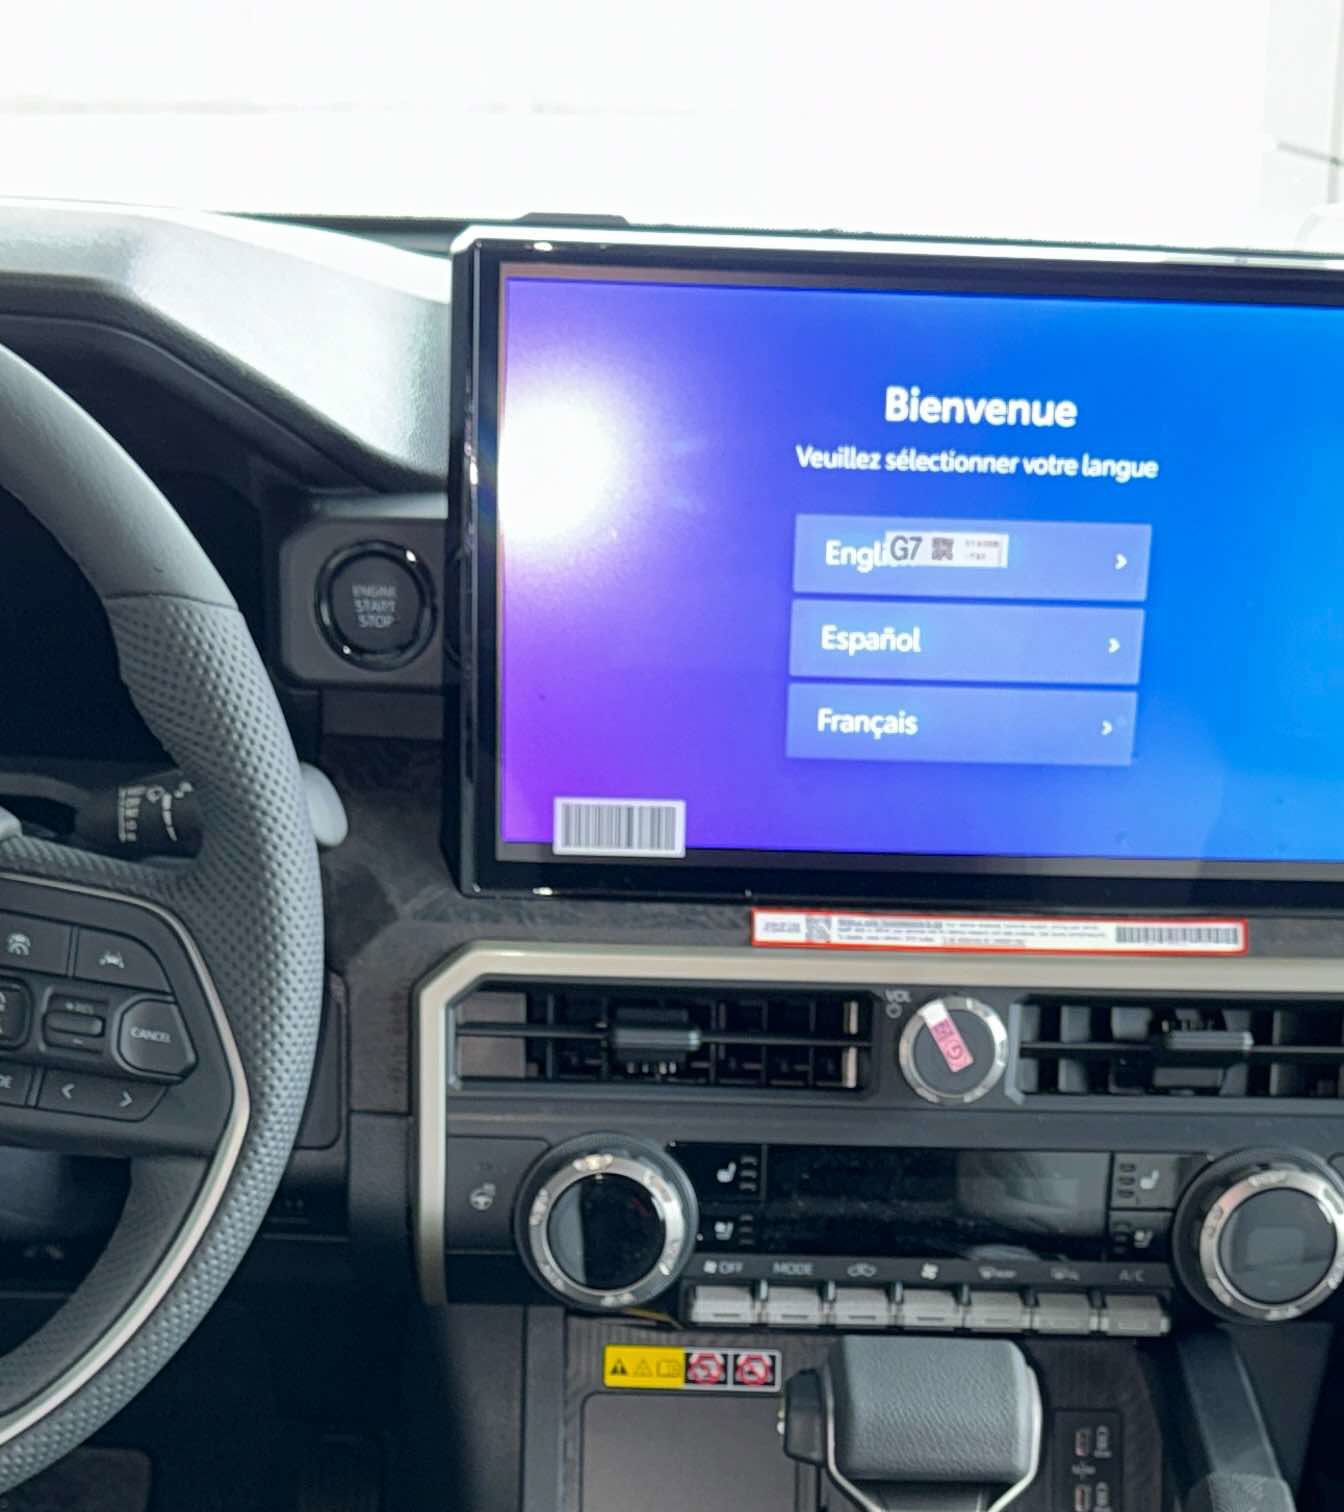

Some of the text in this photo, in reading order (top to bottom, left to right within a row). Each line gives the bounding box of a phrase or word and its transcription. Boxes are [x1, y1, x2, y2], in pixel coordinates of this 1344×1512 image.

[885, 385, 1078, 428] Bienvenue
[795, 444, 1159, 483] Veuillez sélectionner votre langue
[824, 539, 902, 574] Engl
[890, 535, 923, 561] G7
[354, 599, 396, 613] START
[358, 614, 395, 629] STOP
[821, 624, 922, 657] Español
[817, 707, 919, 740] Français
[130, 1025, 172, 1044] CANCEL
[772, 1261, 814, 1276] MODE
